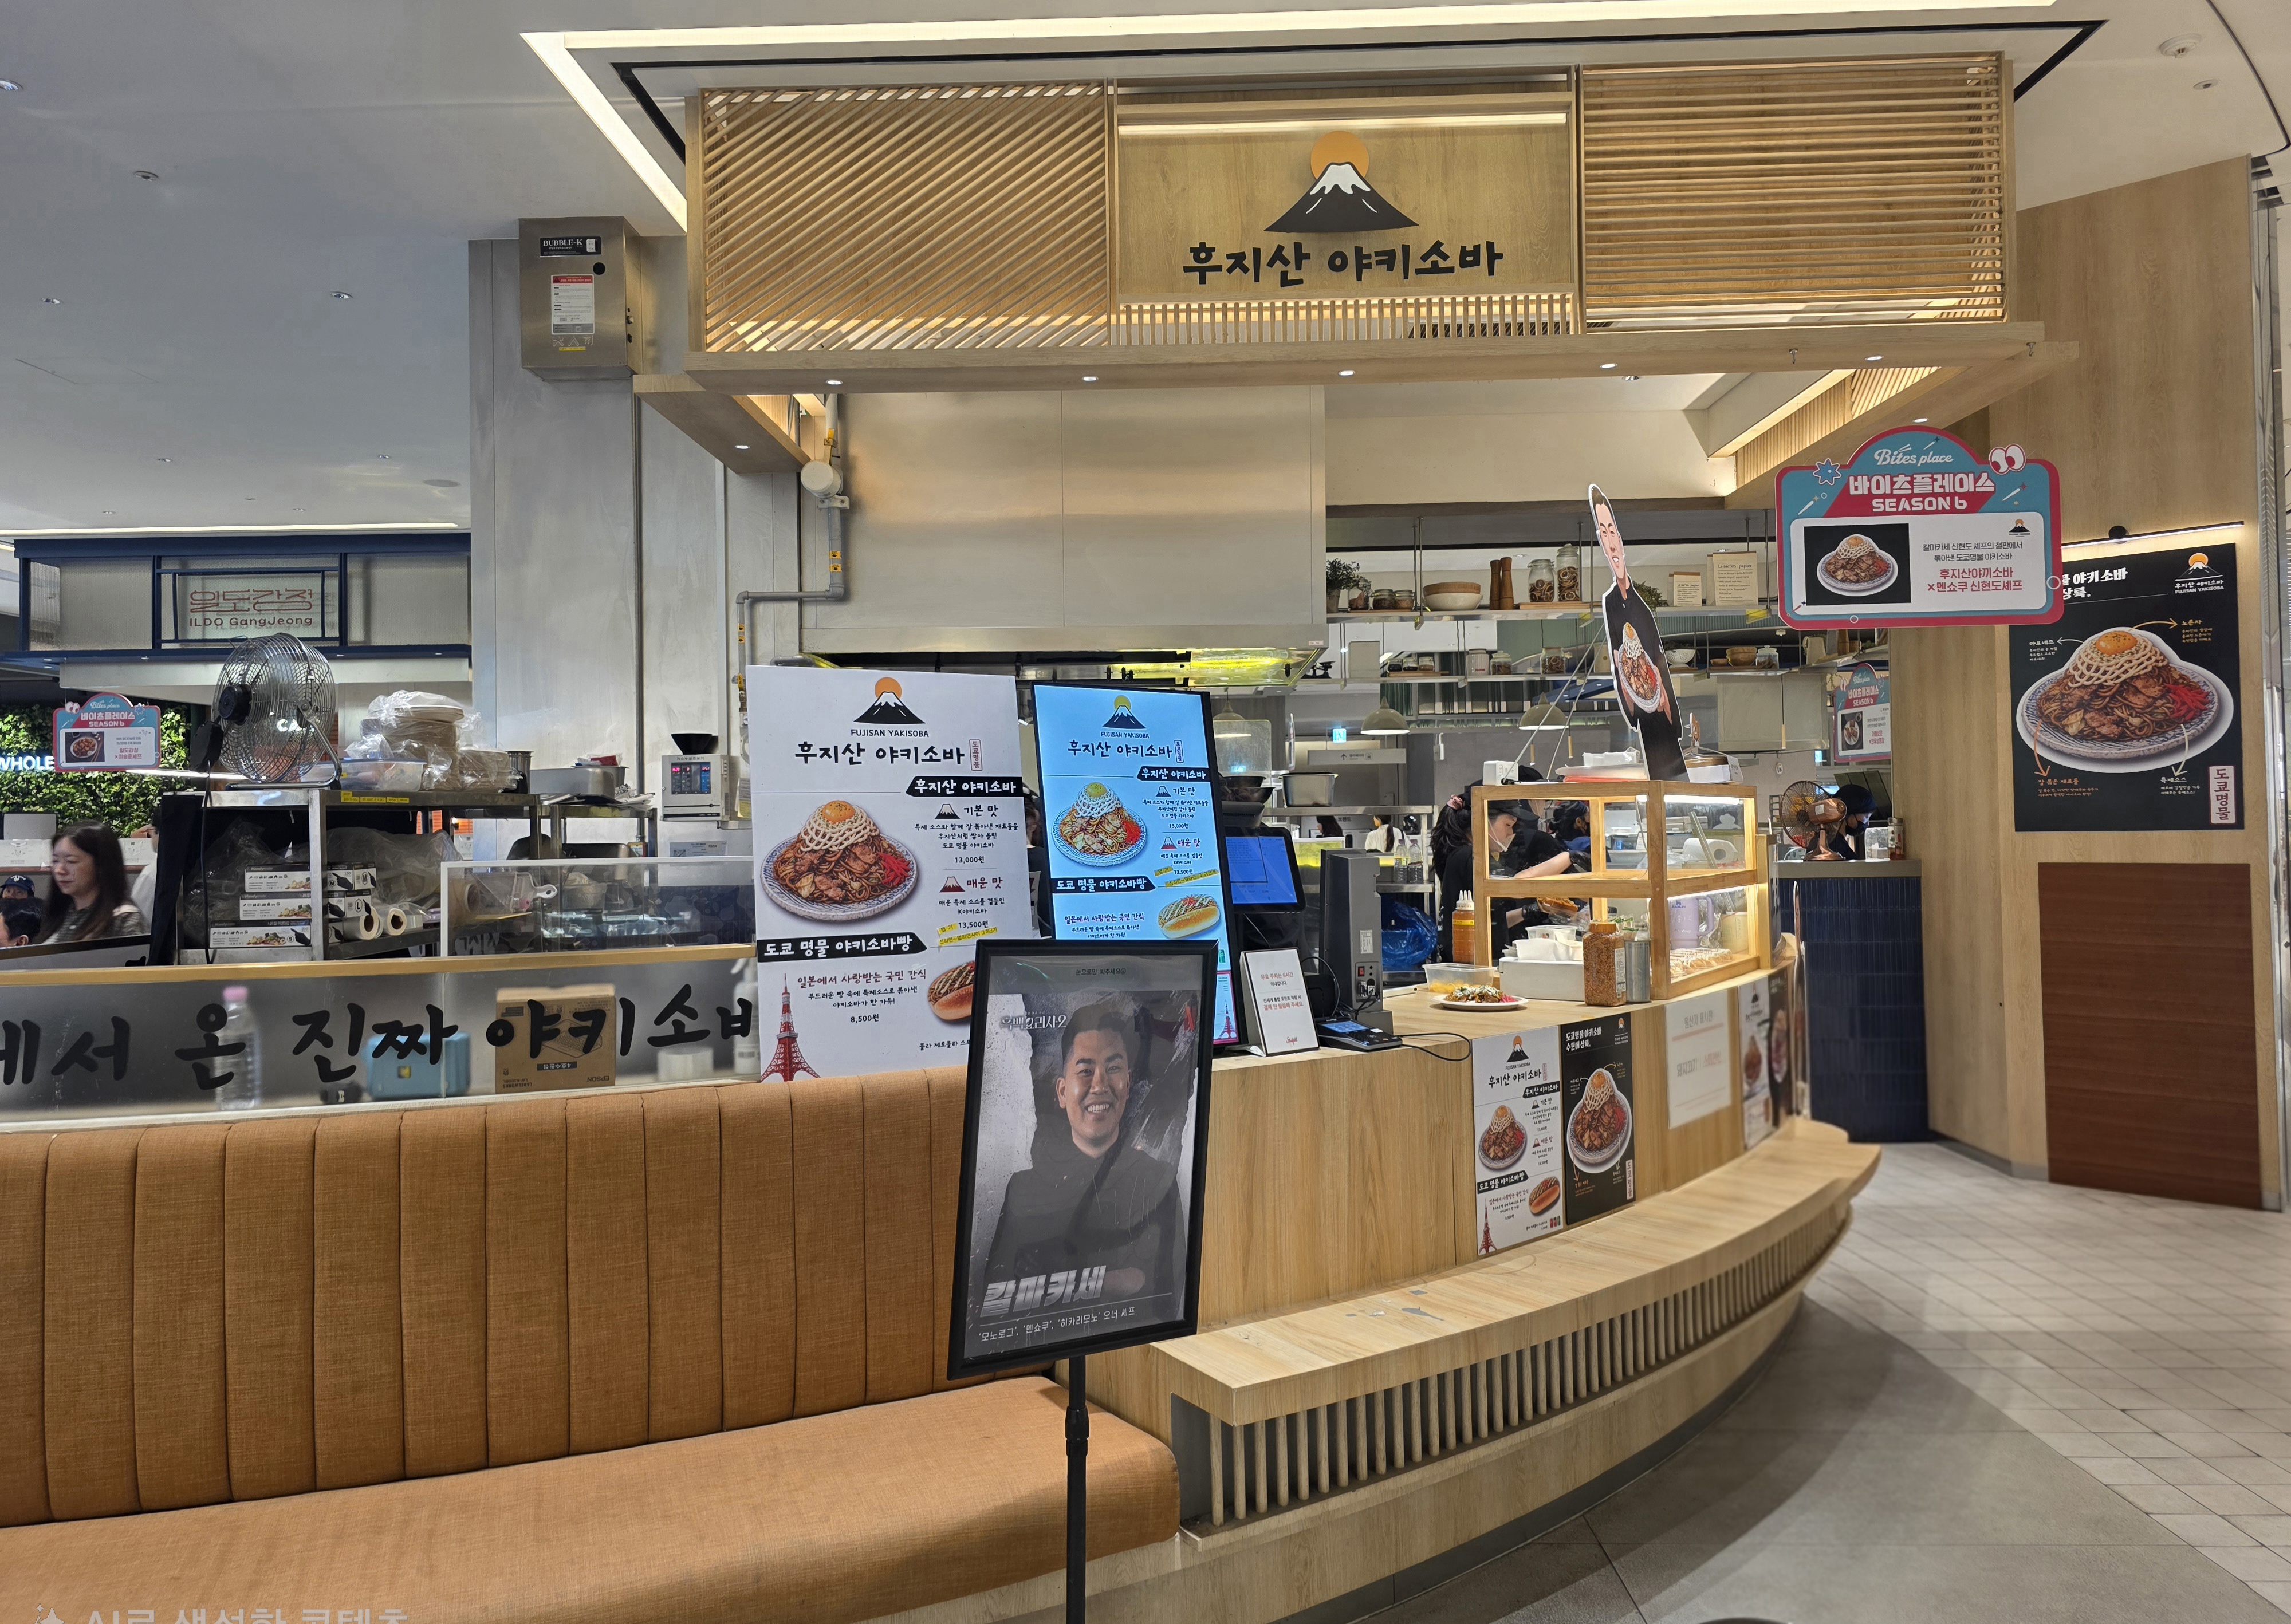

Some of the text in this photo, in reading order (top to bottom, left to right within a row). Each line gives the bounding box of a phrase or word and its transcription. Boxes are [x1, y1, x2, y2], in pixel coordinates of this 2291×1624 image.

[1183, 240, 1503, 287] 후지산 야키소바
[1874, 448, 1954, 467] Bites place
[1849, 472, 1995, 495] 바이츠플레이스
[1872, 498, 1950, 512] SEASON
[1940, 567, 2013, 579] 후지산야끼소바
[1970, 580, 2022, 592] 신현도셰프
[190, 616, 313, 627] ILDO GangJeong
[81, 712, 135, 720] 바이츠플레이스
[851, 729, 929, 738] FUJISAN YAKISOBA
[795, 741, 965, 765] 후지산 야키소바
[1068, 739, 1172, 759] 후지산 야키소바
[0, 756, 54, 771] WHOLE
[1141, 768, 1206, 780] 후지산 야키소바
[914, 779, 1016, 794] 후지산 야키소바
[1173, 787, 1195, 795] 기본 맛
[2214, 768, 2230, 820] 도쿄명물
[964, 805, 998, 817] 기본 맛
[1178, 838, 1200, 847] 매운 맛
[967, 877, 1003, 889] 매운 맛
[1057, 878, 1147, 892] 도쿄 명물 야키소바빵
[958, 920, 989, 929] 13,500원
[1065, 912, 1144, 925] 일본에서 사랑받는 국민 간식
[764, 935, 913, 958] 도쿄 명물 야키소바빵
[797, 969, 927, 988] 일본에서 사랑받는 국민 간식
[808, 991, 834, 1000] 부드러운
[837, 991, 844, 999] 빵
[863, 987, 895, 996] 특제소스로
[897, 986, 918, 994] 볶아낸
[880, 998, 895, 1006] 가득!
[851, 1014, 879, 1023] 8,500원
[1684, 1013, 1698, 1028] 원산지
[174, 1003, 246, 1090] 온
[291, 1003, 458, 1083] 진짜
[1677, 1058, 1697, 1077] 돼지고기
[1489, 1073, 1510, 1088] 후지산
[1513, 1069, 1541, 1082] 야키소바
[1525, 1087, 1538, 1097] 후지산
[980, 1265, 1106, 1317] 칼마카세
[1104, 1309, 1117, 1321] 오너
[1121, 1307, 1135, 1316] 셰프
